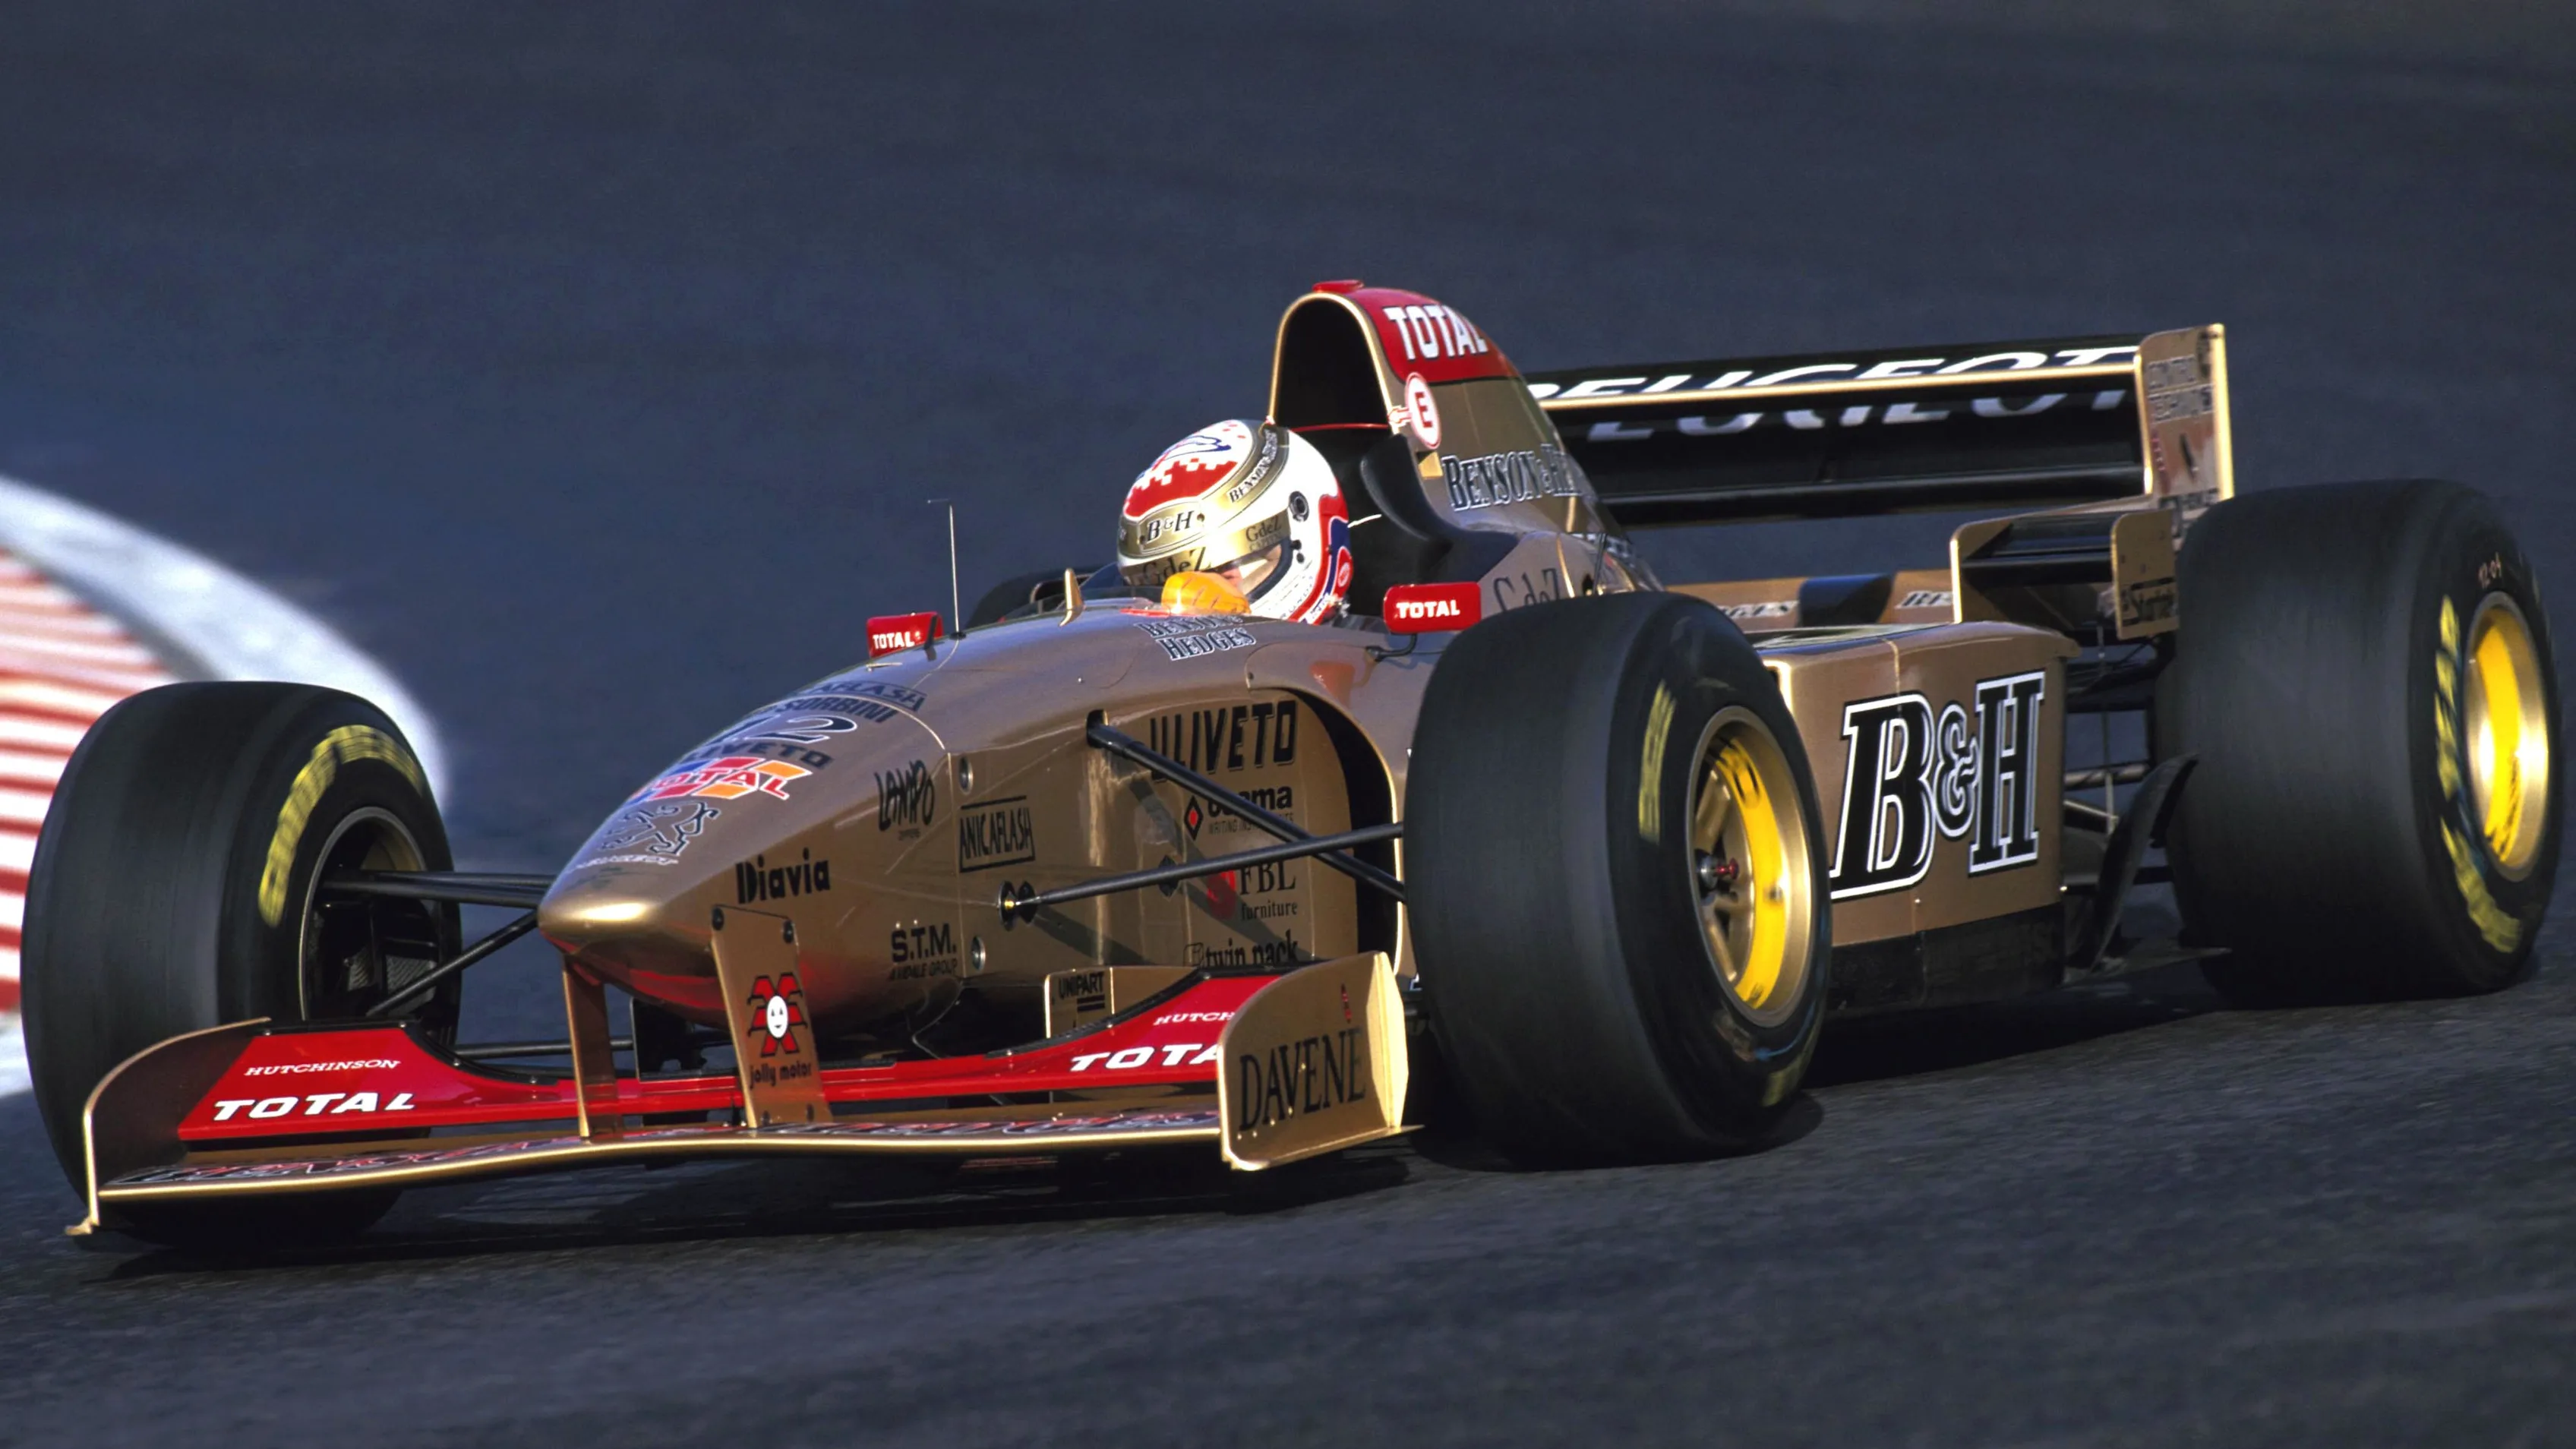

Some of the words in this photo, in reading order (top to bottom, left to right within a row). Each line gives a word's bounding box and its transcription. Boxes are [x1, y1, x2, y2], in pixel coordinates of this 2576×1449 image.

[1383, 305, 1488, 361] TOTAL
[1414, 391, 1433, 429] E
[1441, 453, 1543, 512] BENSON
[1396, 600, 1461, 620] TOTAL
[872, 630, 916, 650] TOTAL
[1155, 627, 1257, 661] HEDGES
[874, 758, 935, 832] LAMPO
[959, 806, 1034, 860] ANICAFLASH
[734, 848, 832, 905] Diavia
[1239, 859, 1296, 895] FBL
[1241, 898, 1298, 921] furniture
[891, 922, 957, 964] S.T.M.
[1058, 971, 1105, 1000] UNIPART
[243, 1059, 401, 1077] HUTCHINSON
[1239, 1027, 1367, 1132] DAVENE
[213, 1092, 416, 1122] TOTAL
